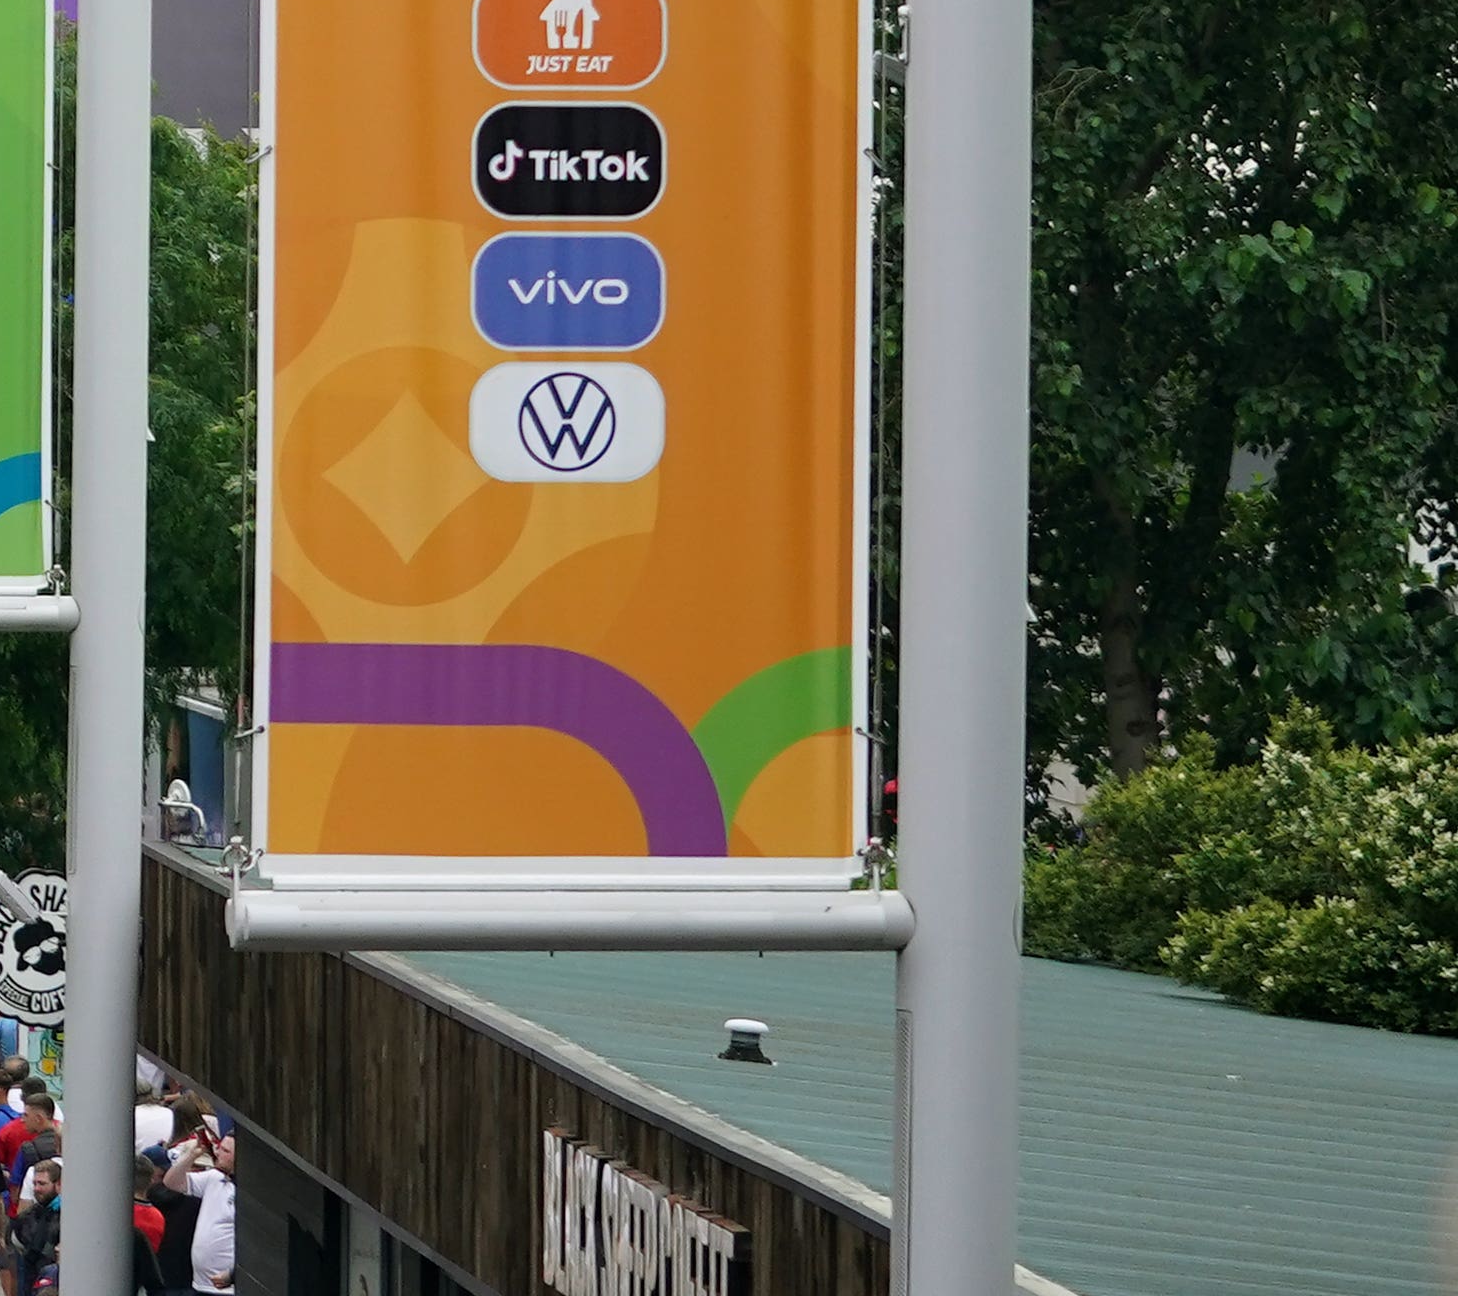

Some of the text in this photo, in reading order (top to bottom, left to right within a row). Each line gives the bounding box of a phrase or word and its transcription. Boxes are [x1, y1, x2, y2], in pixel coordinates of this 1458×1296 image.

[526, 56, 613, 74] JUST EAT
[528, 150, 650, 181] TikTok
[508, 270, 628, 305] vivo
